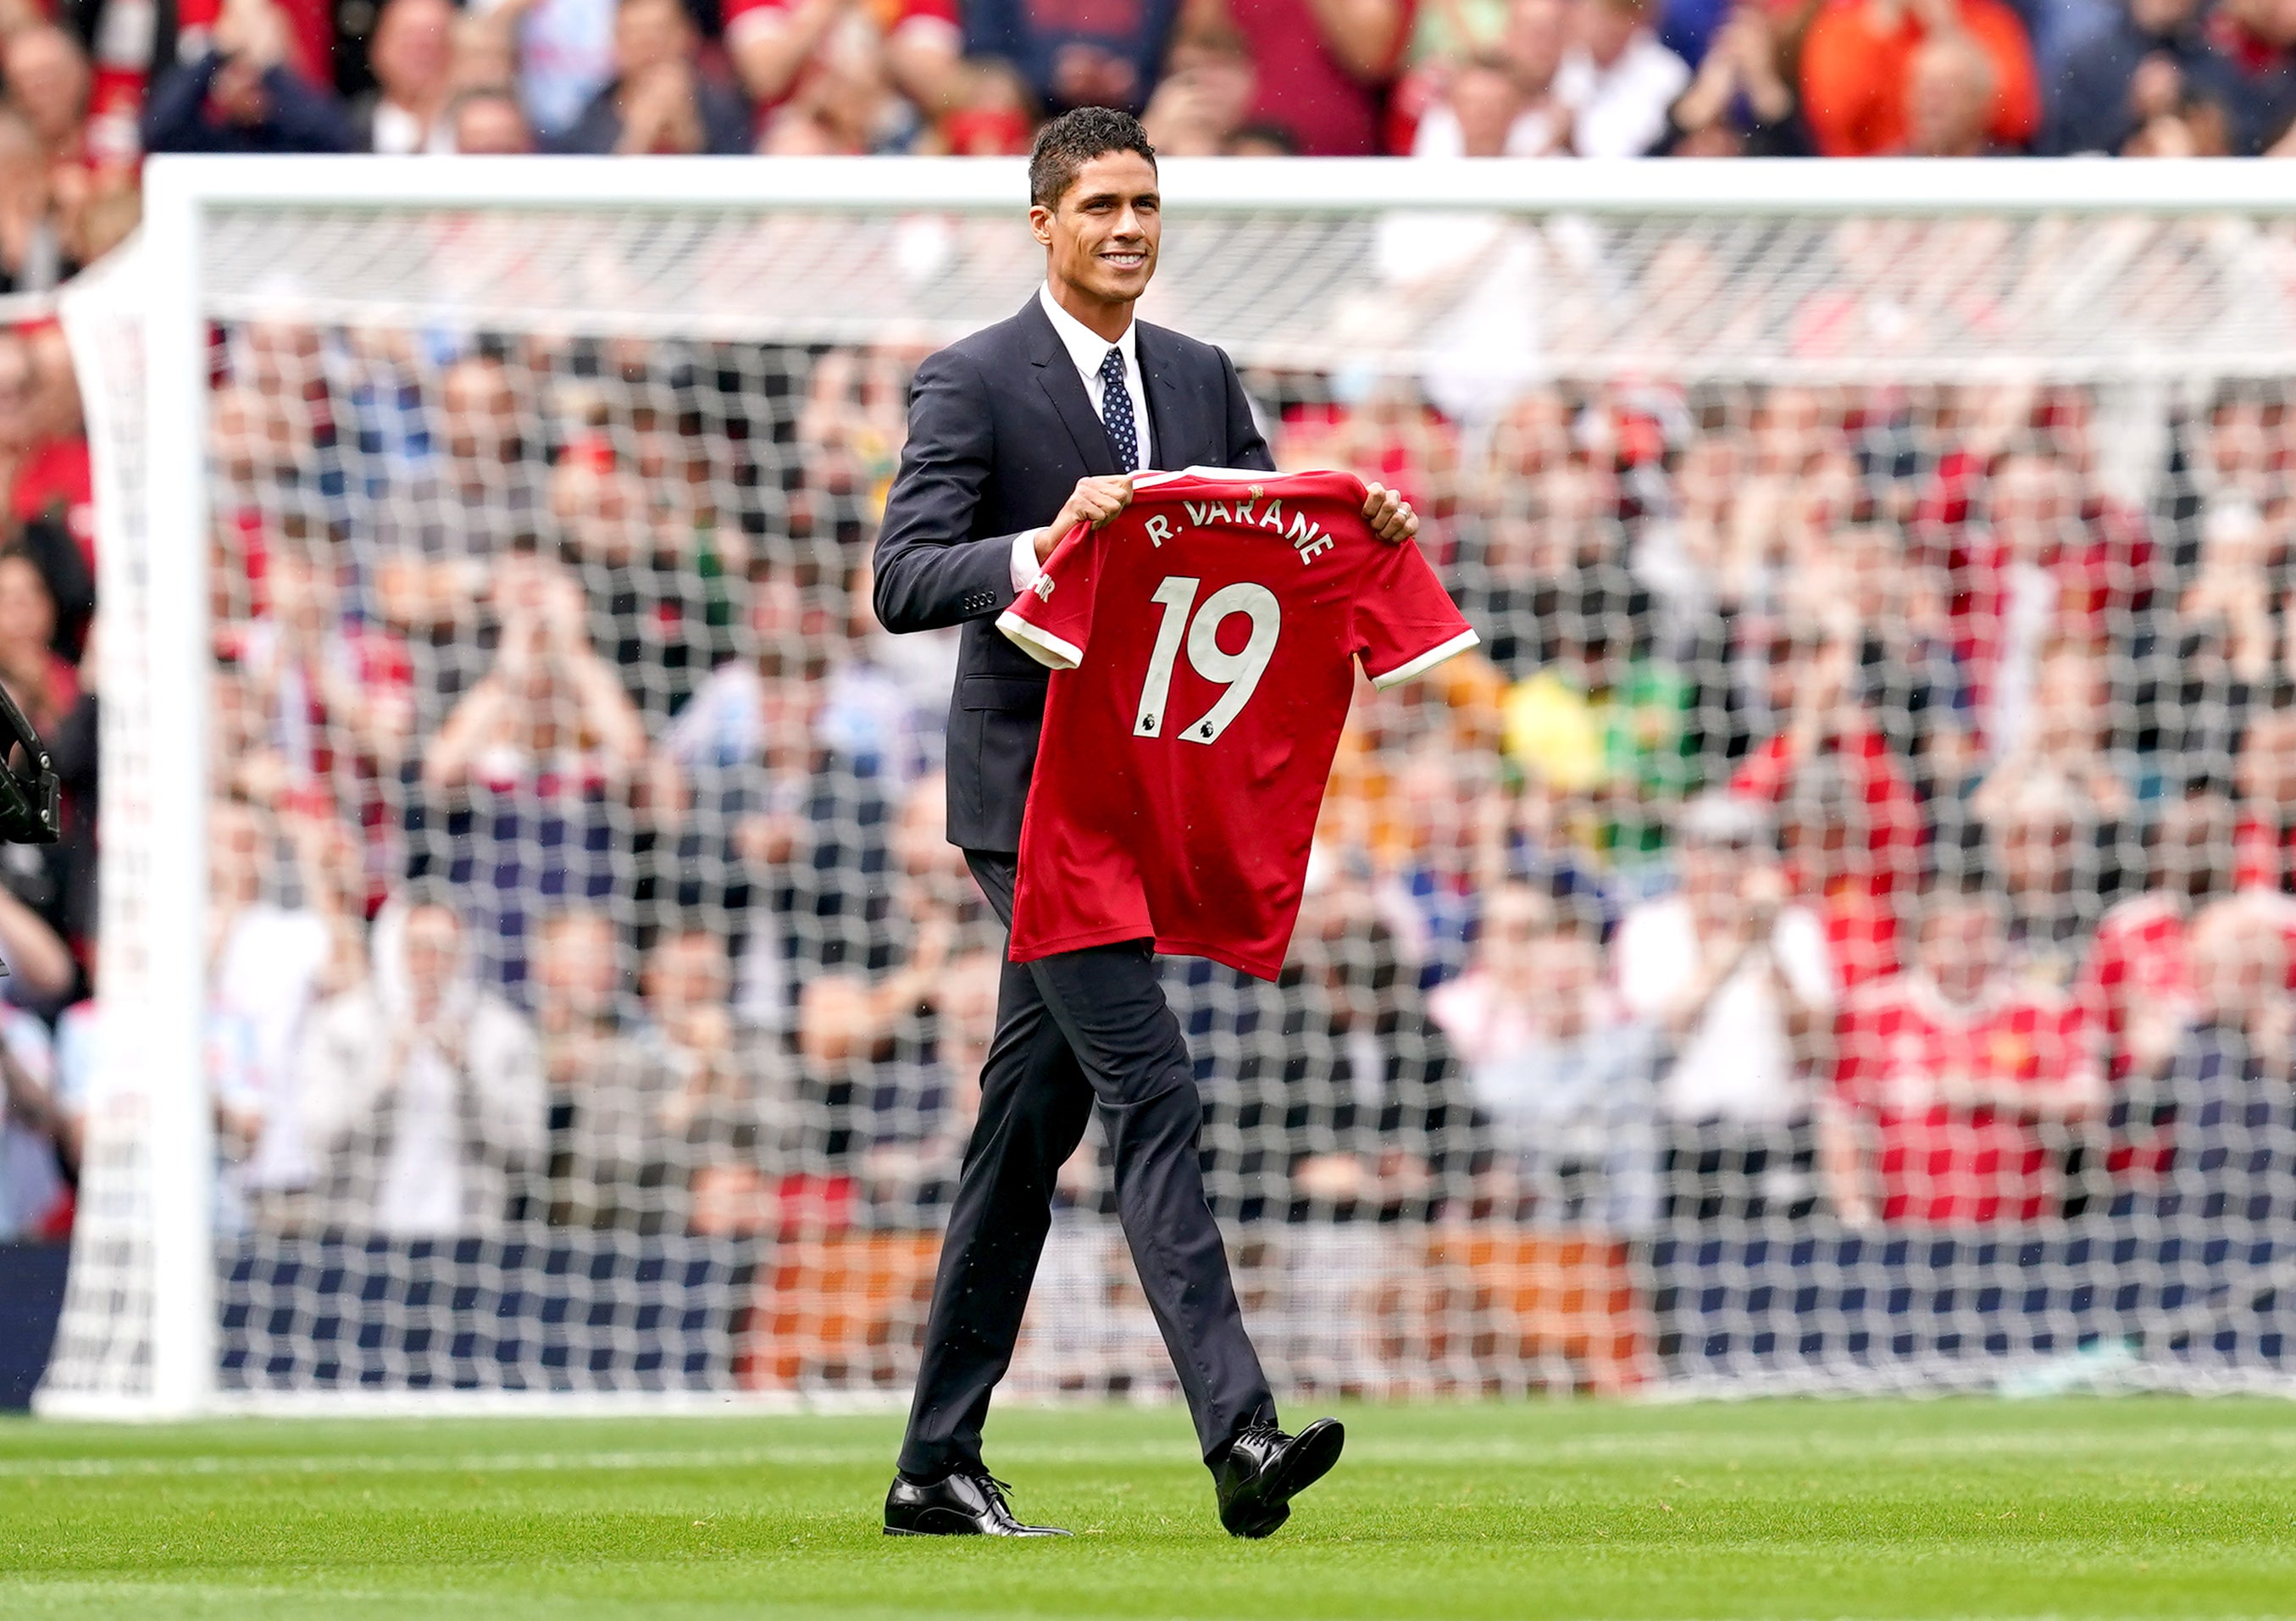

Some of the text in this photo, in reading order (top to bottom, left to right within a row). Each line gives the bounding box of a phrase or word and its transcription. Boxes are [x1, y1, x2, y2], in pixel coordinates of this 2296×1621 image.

[1144, 498, 1335, 566] R. VARANE
[1133, 575, 1281, 746] 19
